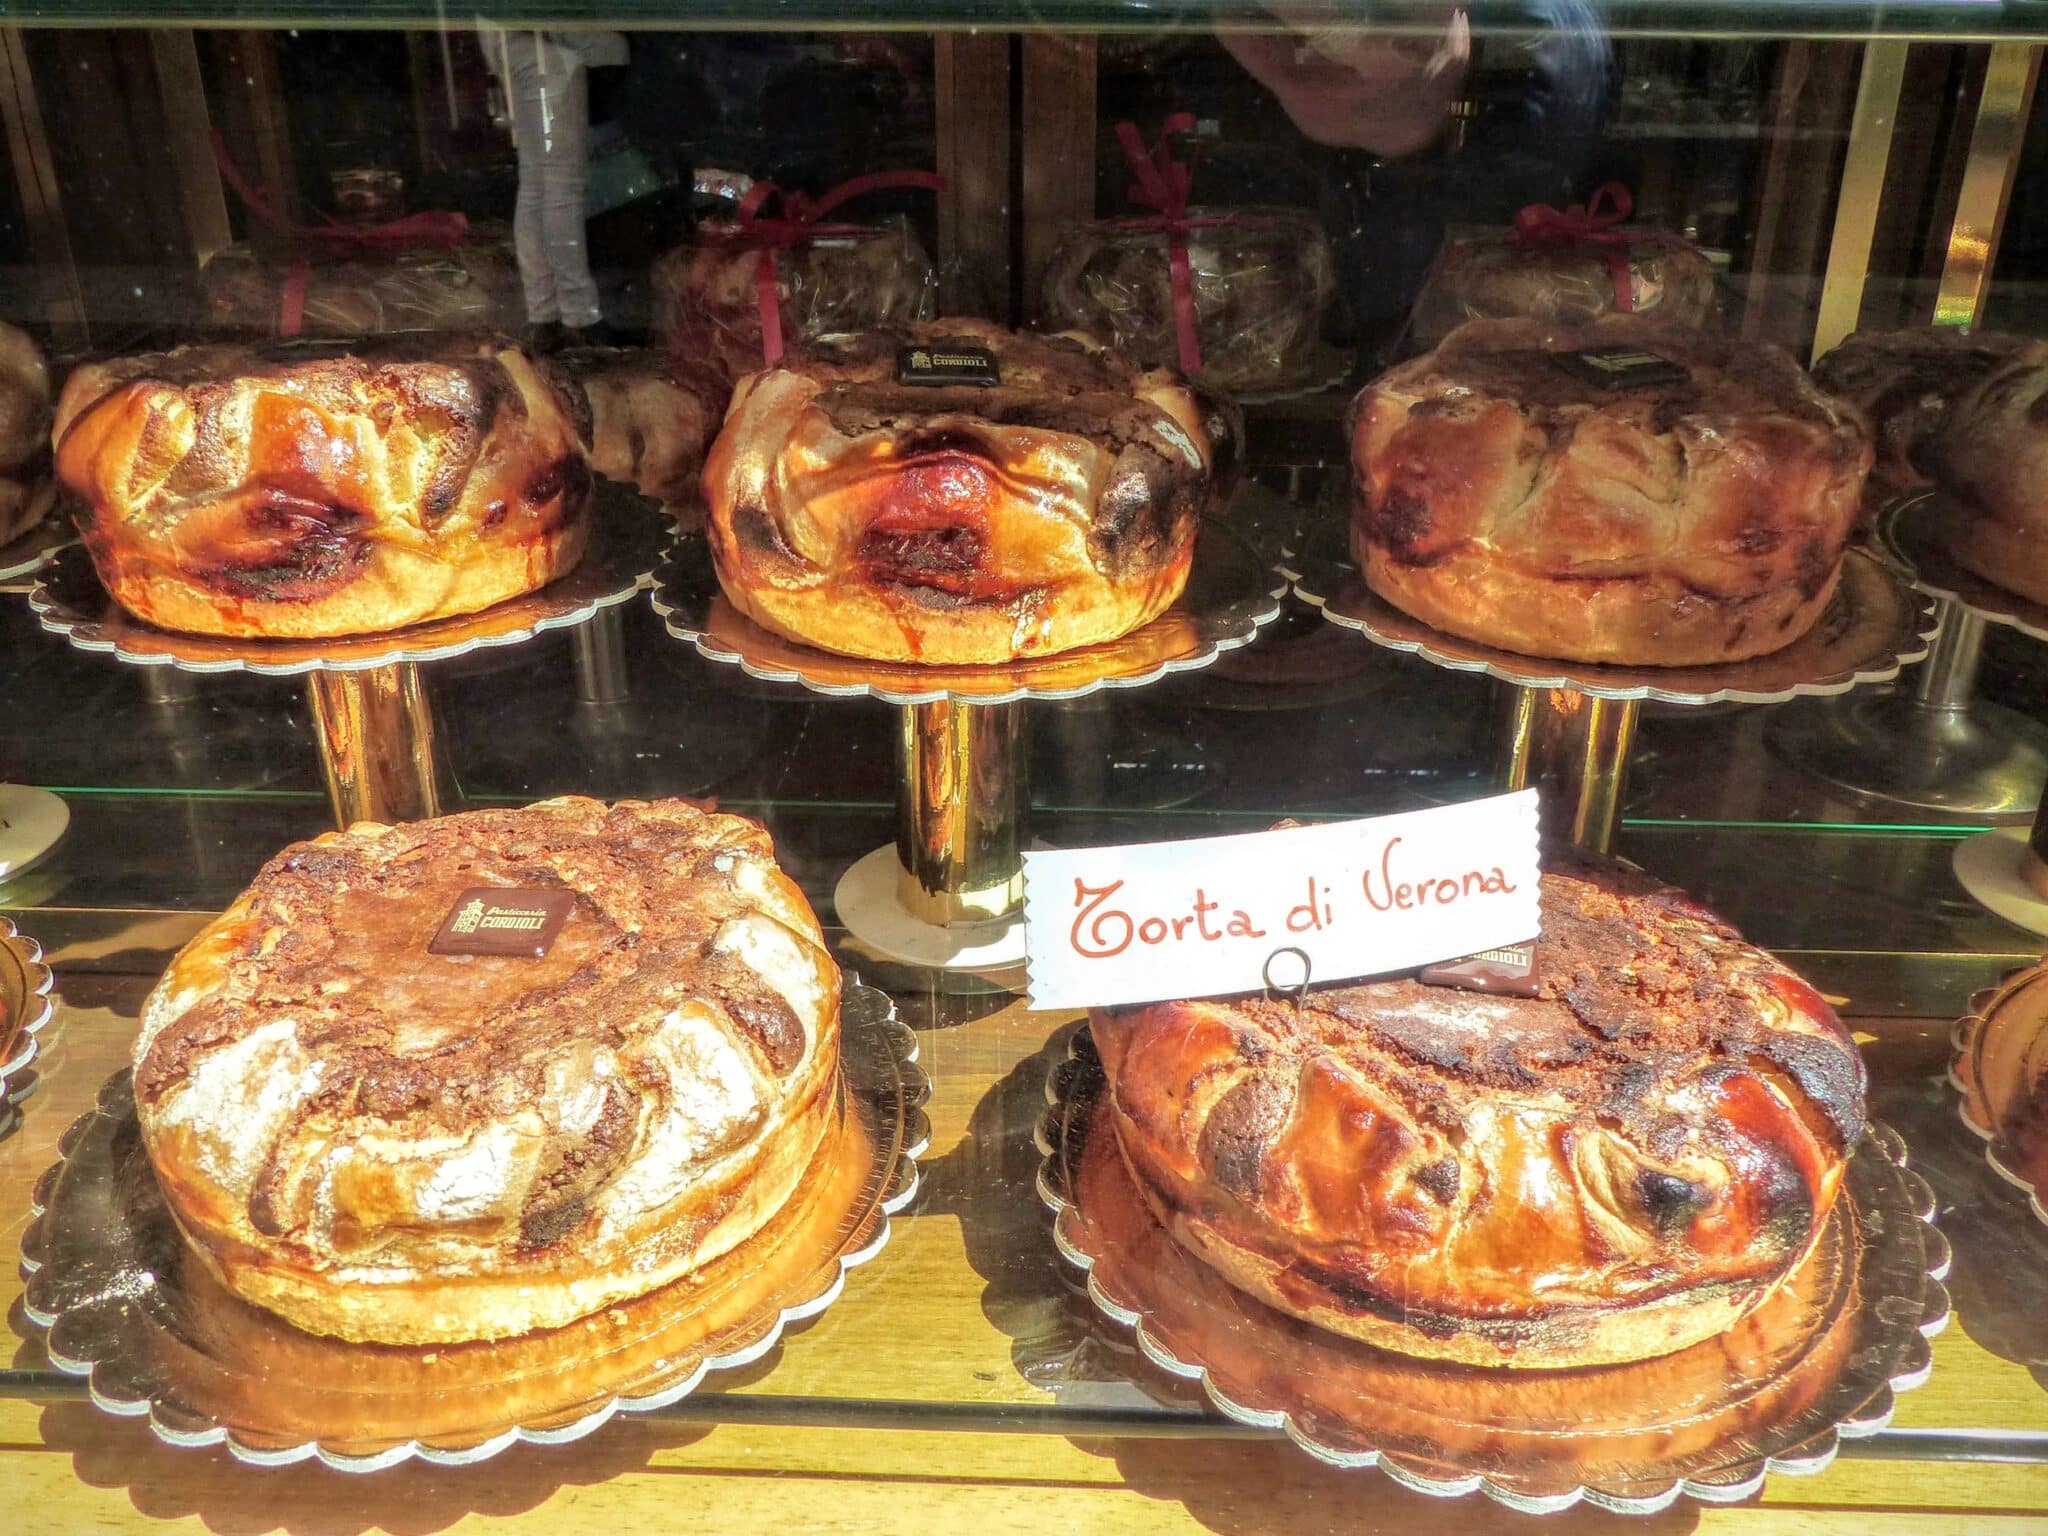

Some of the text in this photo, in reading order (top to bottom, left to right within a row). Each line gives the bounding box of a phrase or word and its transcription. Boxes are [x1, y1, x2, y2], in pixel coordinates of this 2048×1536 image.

[480, 916, 545, 930] CORDIOLI
[1071, 837, 1517, 958] Torta di Verona
